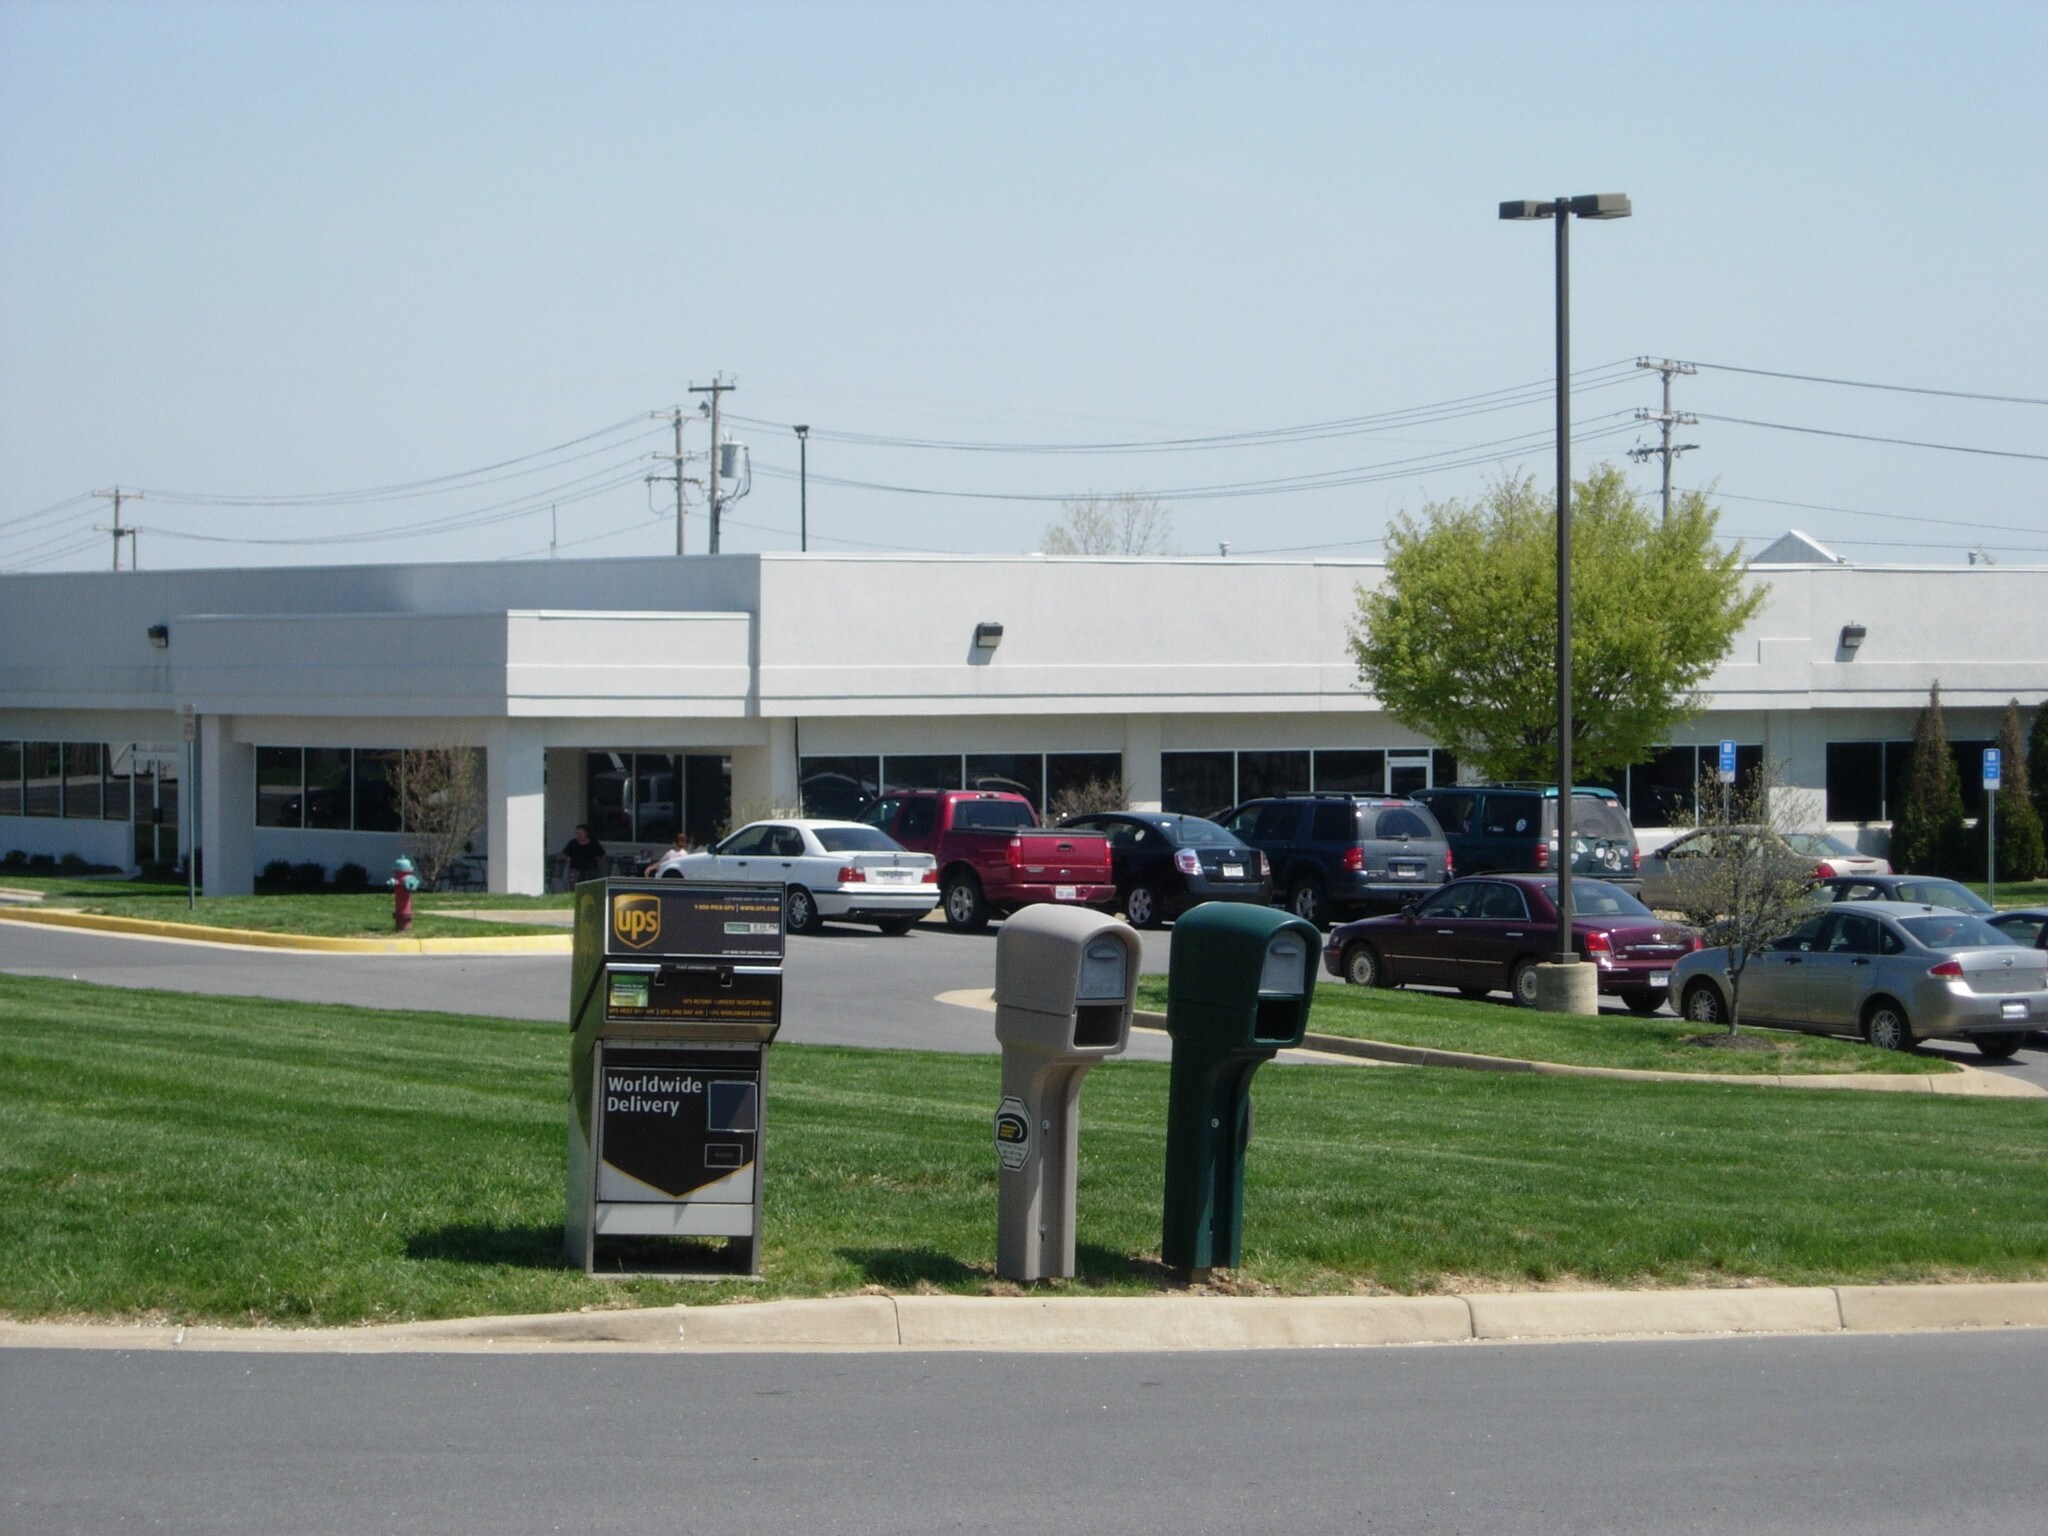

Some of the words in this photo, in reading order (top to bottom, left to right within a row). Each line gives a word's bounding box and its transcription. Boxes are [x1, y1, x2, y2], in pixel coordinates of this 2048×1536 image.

[618, 910, 657, 940] ups
[608, 1076, 703, 1093] Worldwide
[607, 1096, 680, 1117] Delivery
